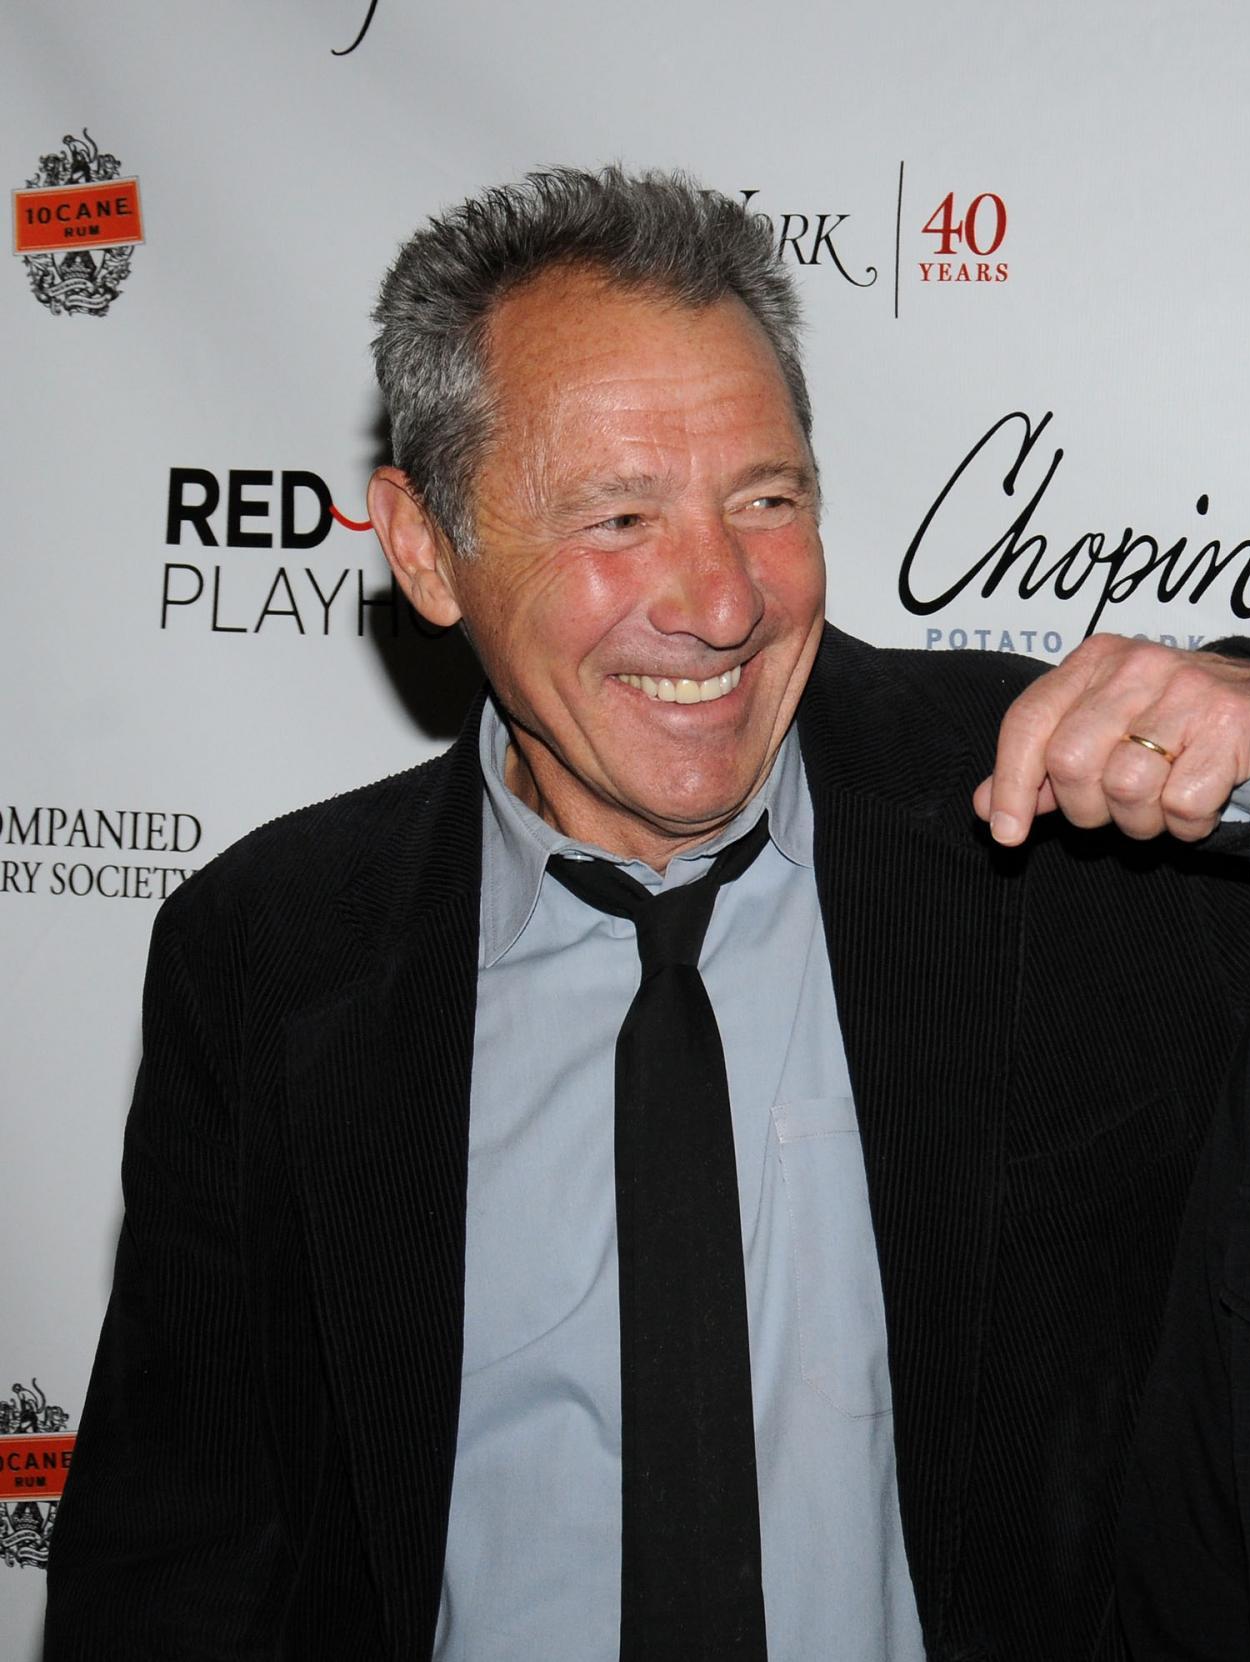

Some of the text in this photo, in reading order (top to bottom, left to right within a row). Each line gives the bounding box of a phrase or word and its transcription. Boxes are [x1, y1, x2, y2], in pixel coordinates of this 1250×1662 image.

[64, 225, 100, 238] RUM
[921, 191, 1008, 255] 40
[918, 262, 1010, 282] YEARS
[166, 467, 334, 549] RED
[161, 563, 452, 639] PLAYH
[926, 628, 1063, 653] POTATO
[0, 806, 202, 853] MPANIED
[15, 1476, 47, 1488] RUM
